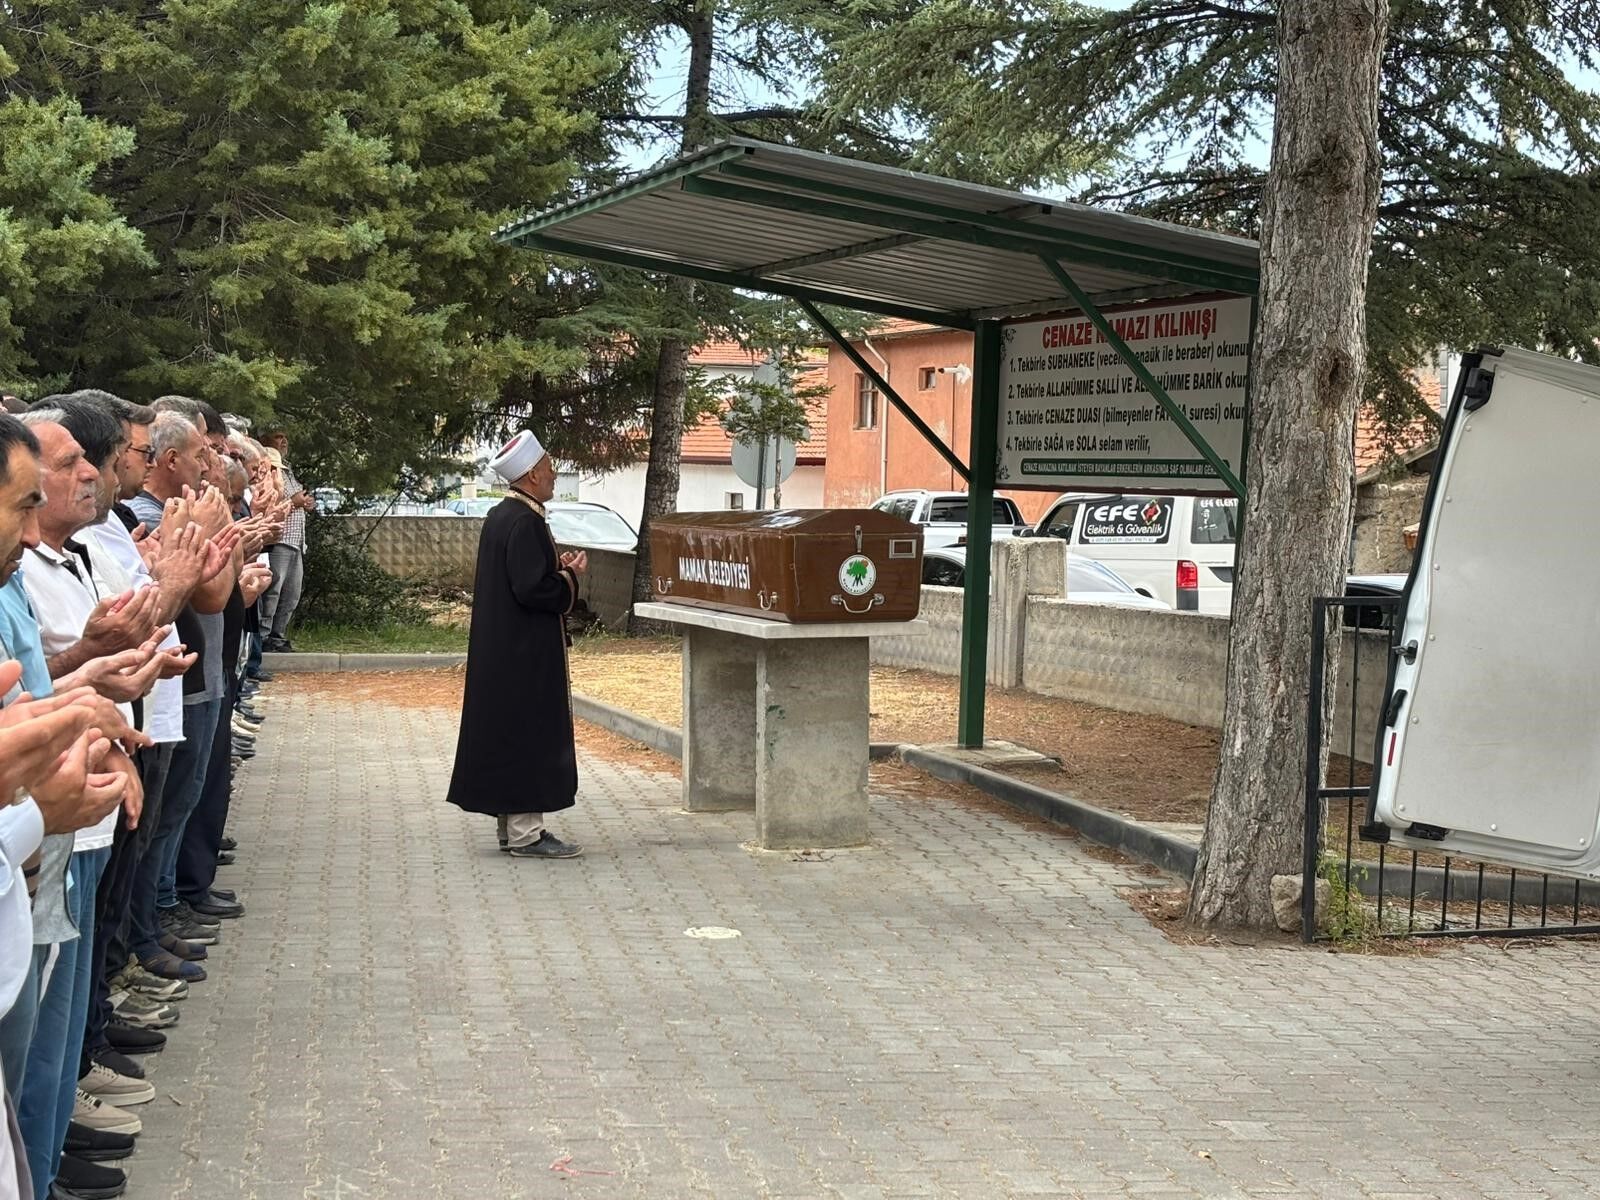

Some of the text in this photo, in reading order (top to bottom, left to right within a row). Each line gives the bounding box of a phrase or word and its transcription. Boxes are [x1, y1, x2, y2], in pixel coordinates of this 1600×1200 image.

[1042, 323, 1093, 349] CENAZE
[1154, 308, 1218, 340] KILINIŞI
[1010, 358, 1016, 372] 1.
[1018, 355, 1046, 372] Tekbirle
[1048, 351, 1095, 370] SUBHANEKE
[1162, 345, 1174, 362] ile
[1176, 341, 1214, 363] beraber)
[1008, 384, 1015, 399] 2.
[1017, 382, 1045, 399] Tekbirle
[1096, 374, 1119, 394] SALLİ
[1122, 377, 1132, 393] VE
[1193, 367, 1223, 389] BARİK
[1007, 410, 1013, 425] 3.
[1015, 409, 1044, 426] Tekbirle
[1045, 407, 1075, 425] CENAZE
[1077, 407, 1101, 423] DUASI
[1103, 405, 1153, 427] (bilmeyenler
[1189, 403, 1221, 424] suresi)
[1006, 436, 1012, 451] 4.
[1014, 435, 1042, 452] Tekbirle
[1044, 433, 1064, 452] SAĞA
[1065, 439, 1074, 452] ve
[1076, 435, 1097, 452] SOLA
[1099, 435, 1123, 452] selam
[1094, 504, 1139, 521] EFE
[1215, 498, 1239, 507] ELEKT
[1087, 523, 1163, 535] Elektrik & Güvenlik
[679, 553, 751, 590] MAMAK BELEDİYESİ
